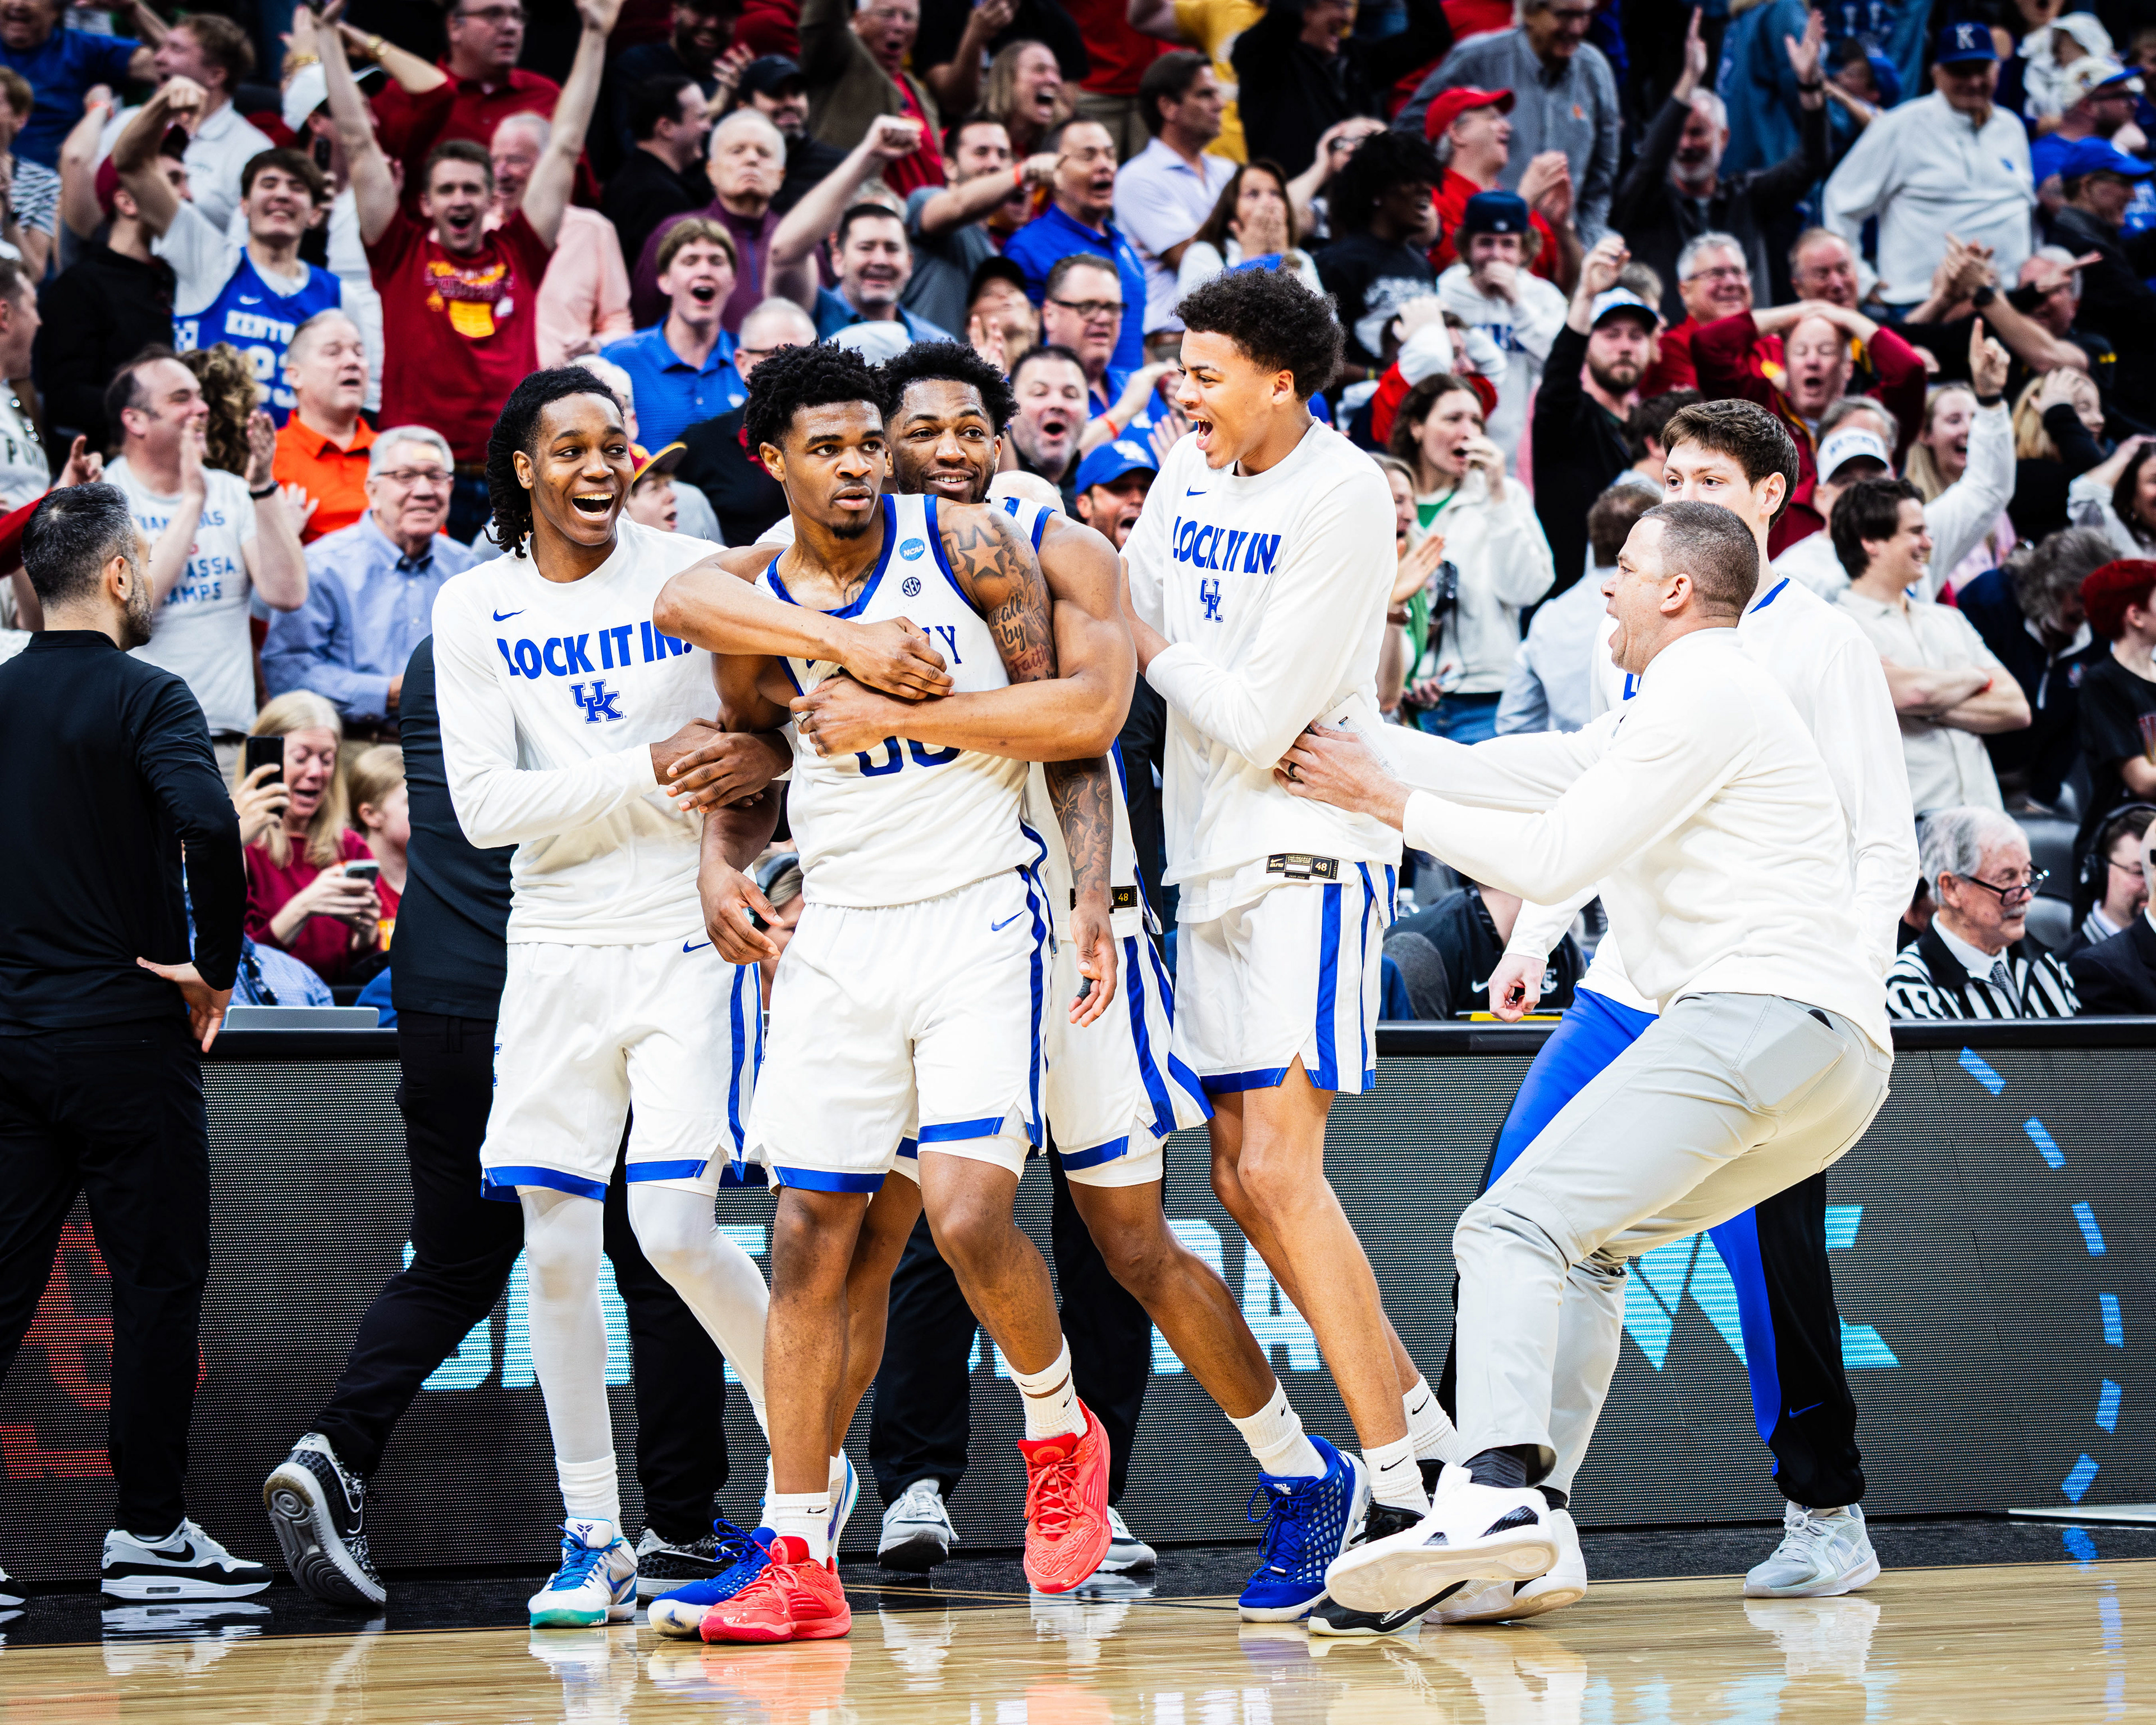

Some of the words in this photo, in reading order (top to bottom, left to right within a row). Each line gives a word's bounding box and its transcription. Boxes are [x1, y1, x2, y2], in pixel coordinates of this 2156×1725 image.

[225, 309, 296, 345] KENTU
[903, 545, 925, 556] NCAA
[1173, 515, 1226, 570] LOCK
[1222, 530, 1249, 572] IT
[902, 577, 921, 596] SEC
[1199, 577, 1224, 623] UK
[990, 593, 1024, 627] walk
[496, 633, 596, 680] LOCK
[599, 624, 633, 670] IT
[1001, 623, 1026, 651] by
[569, 678, 624, 724] UK
[1314, 861, 1328, 872] 48
[1118, 893, 1129, 902] 48
